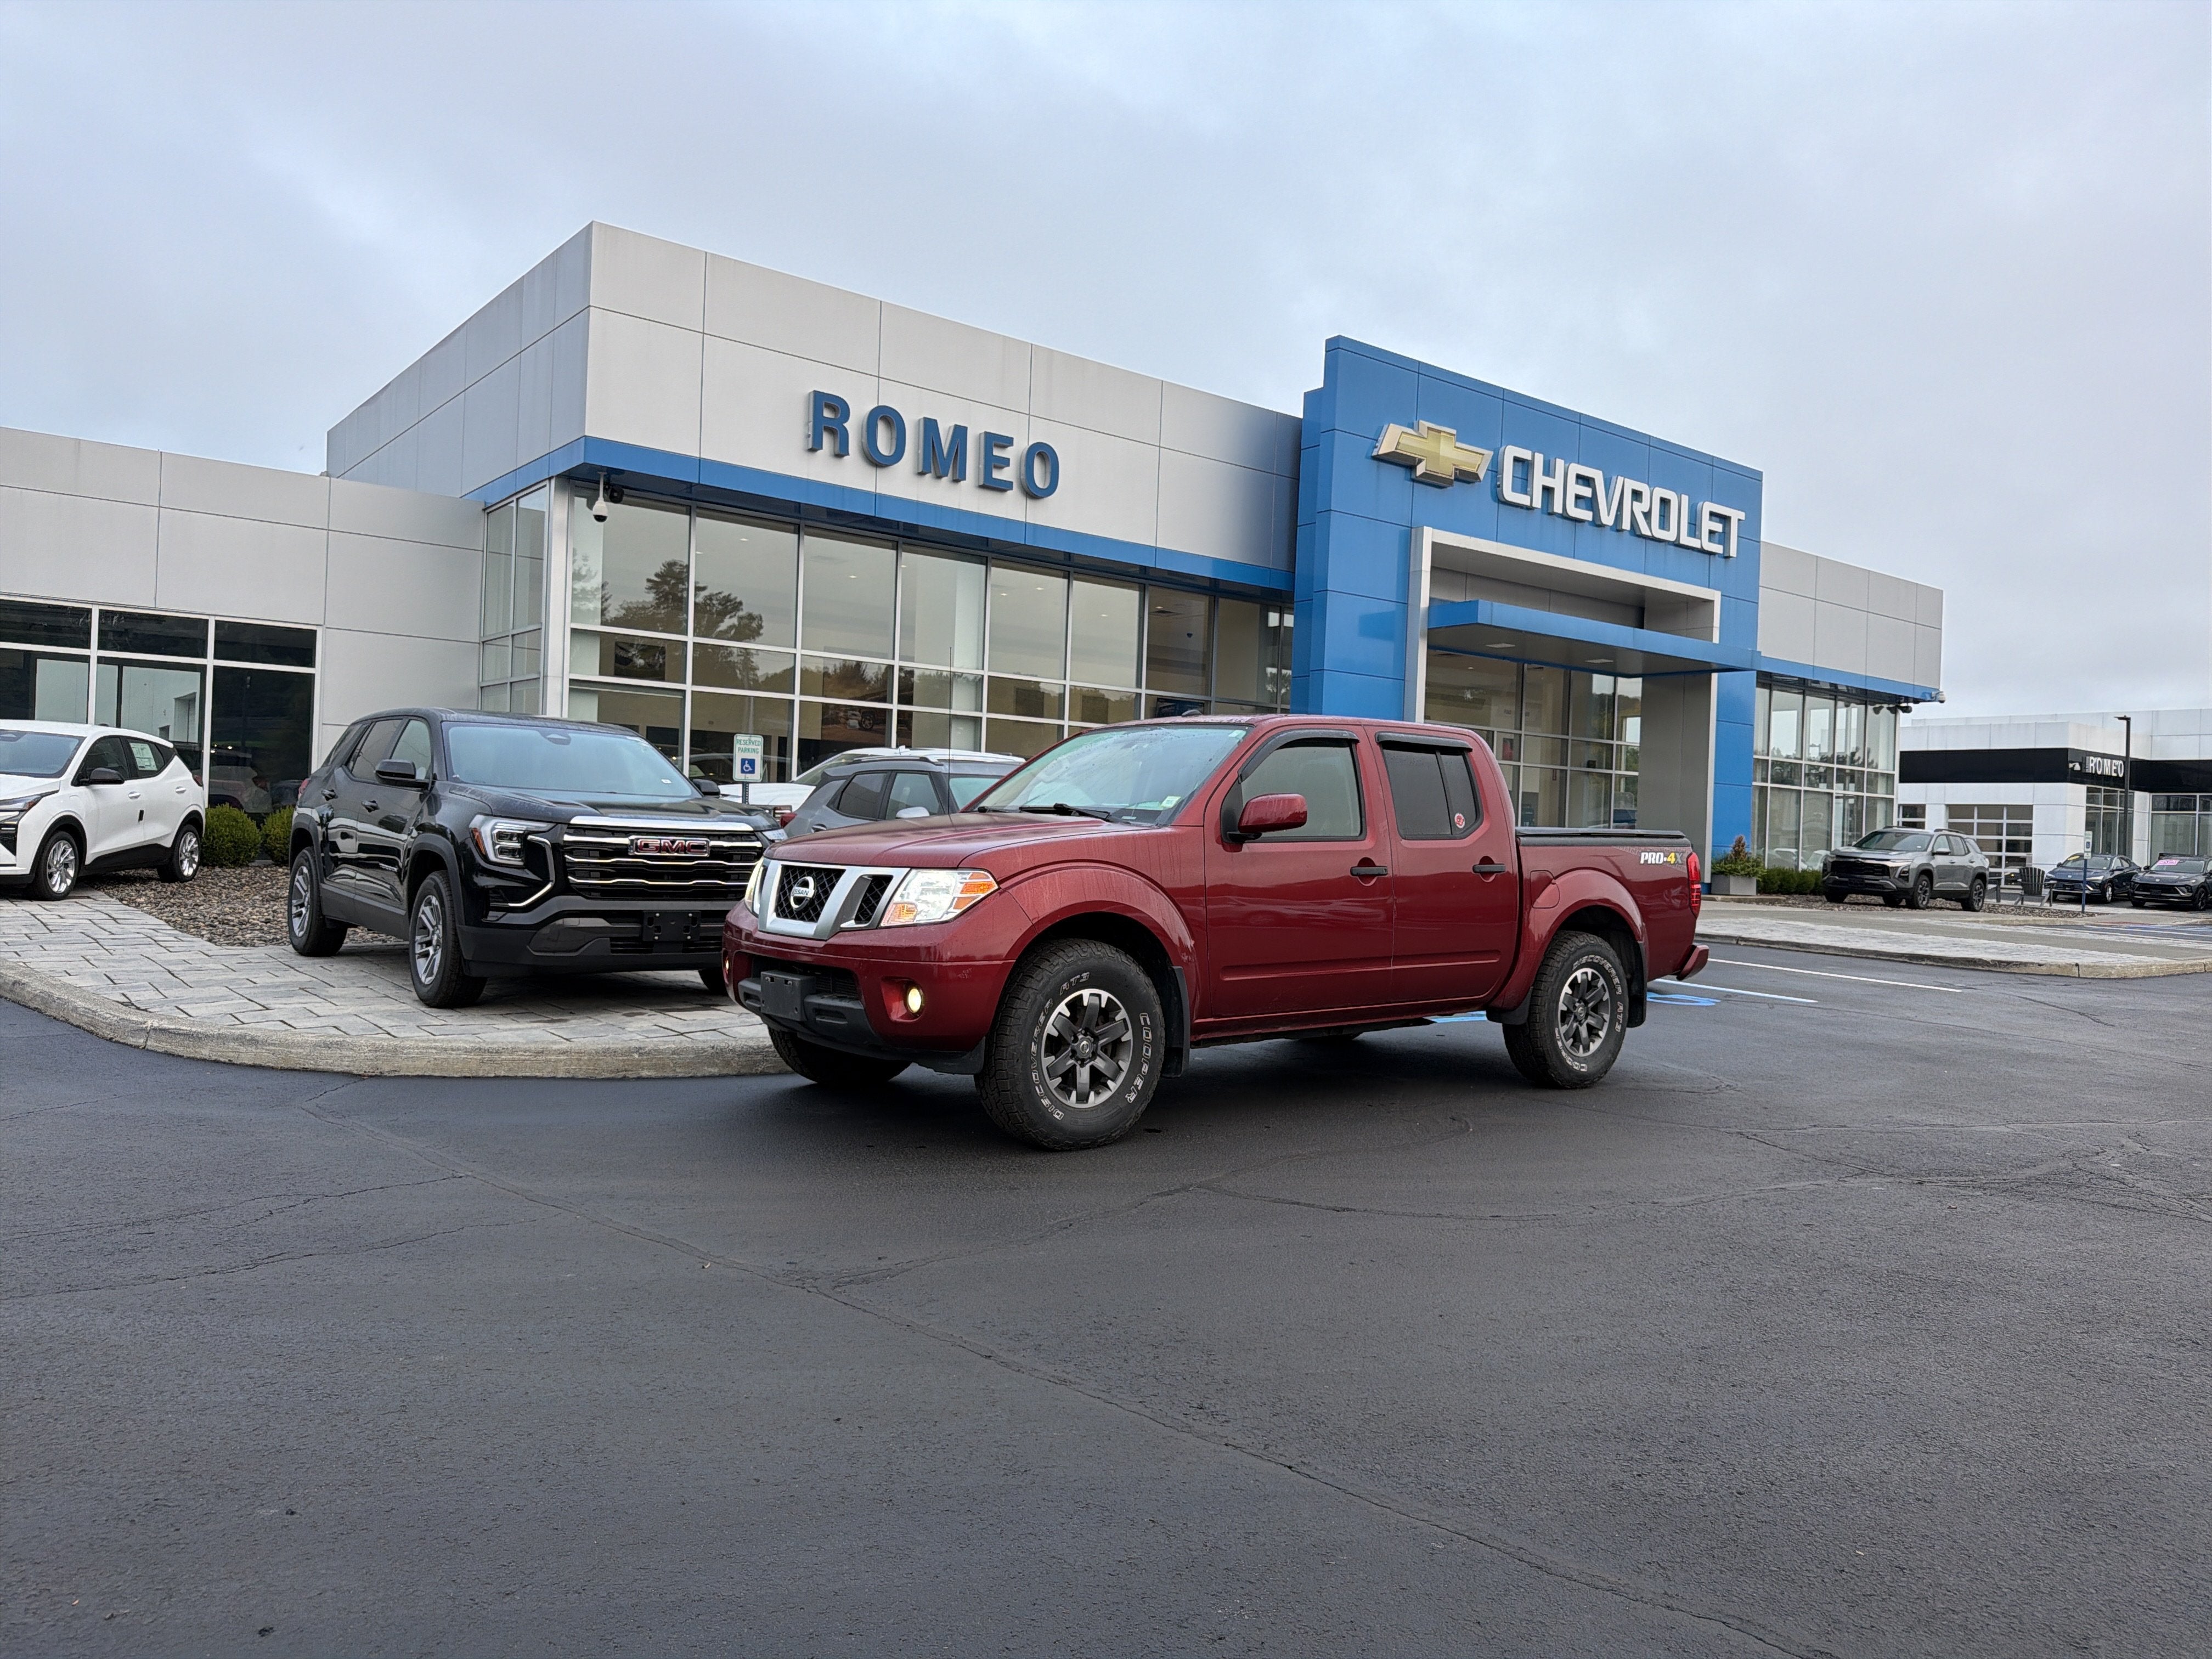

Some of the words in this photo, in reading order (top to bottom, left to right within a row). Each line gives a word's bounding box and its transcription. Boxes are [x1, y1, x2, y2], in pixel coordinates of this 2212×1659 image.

[808, 390, 1059, 499] ROMEO
[1498, 445, 1746, 558] CHEVROLET
[2087, 757, 2124, 777] ROMEO
[637, 839, 707, 854] GMC
[1030, 998, 1064, 1120] DISCOVERER
[1059, 972, 1090, 996] AT3
[1125, 1013, 1152, 1103] COOPER
[1615, 1001, 1623, 1032] AT3
